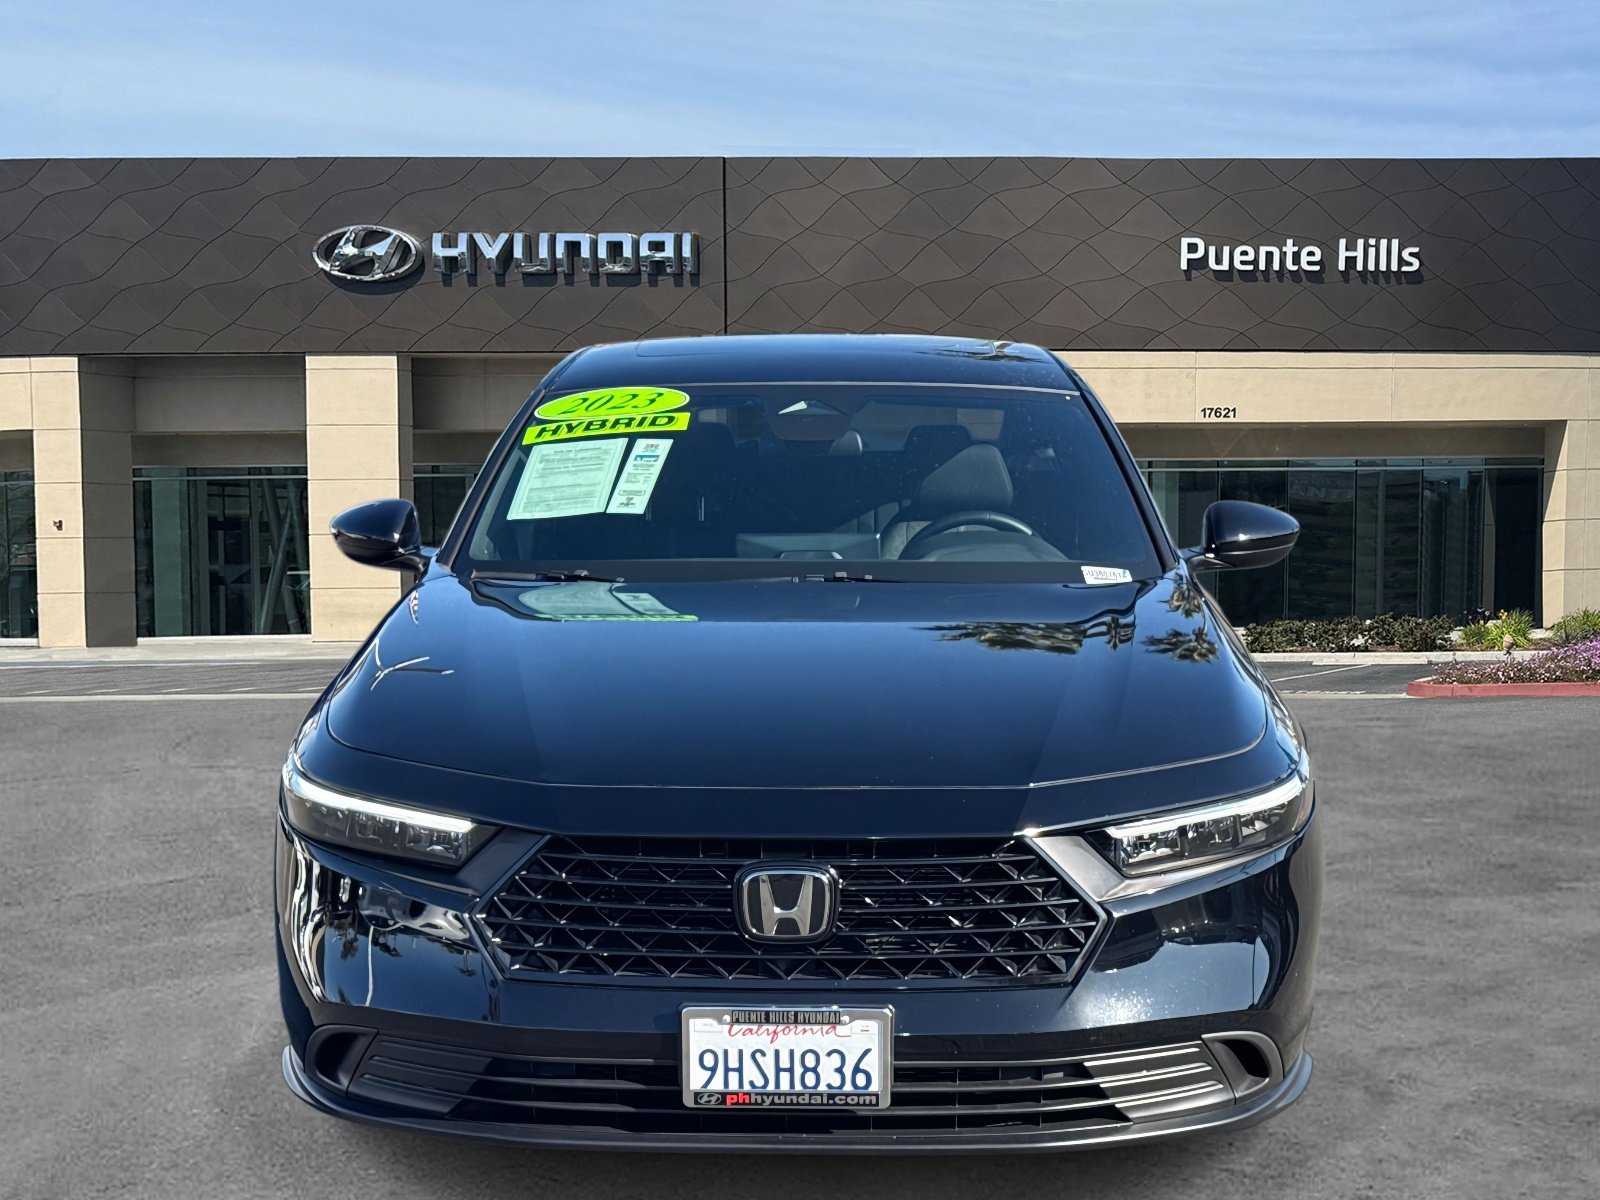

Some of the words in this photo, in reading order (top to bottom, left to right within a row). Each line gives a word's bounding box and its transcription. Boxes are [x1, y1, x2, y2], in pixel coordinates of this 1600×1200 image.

[432, 232, 696, 273] HYUNDAI
[1180, 237, 1322, 272] Puente
[1338, 238, 1421, 272] Hills
[560, 392, 665, 415] 2023
[1200, 407, 1237, 419] 17621
[535, 415, 677, 439] HYBRID
[732, 1011, 765, 1023] PUENTE
[769, 1011, 795, 1023] HILLS
[797, 1012, 840, 1024] HYUNDAI
[727, 1024, 851, 1044] California
[698, 1048, 873, 1090] 9HSH836
[726, 1093, 877, 1106] phhyundai.com
